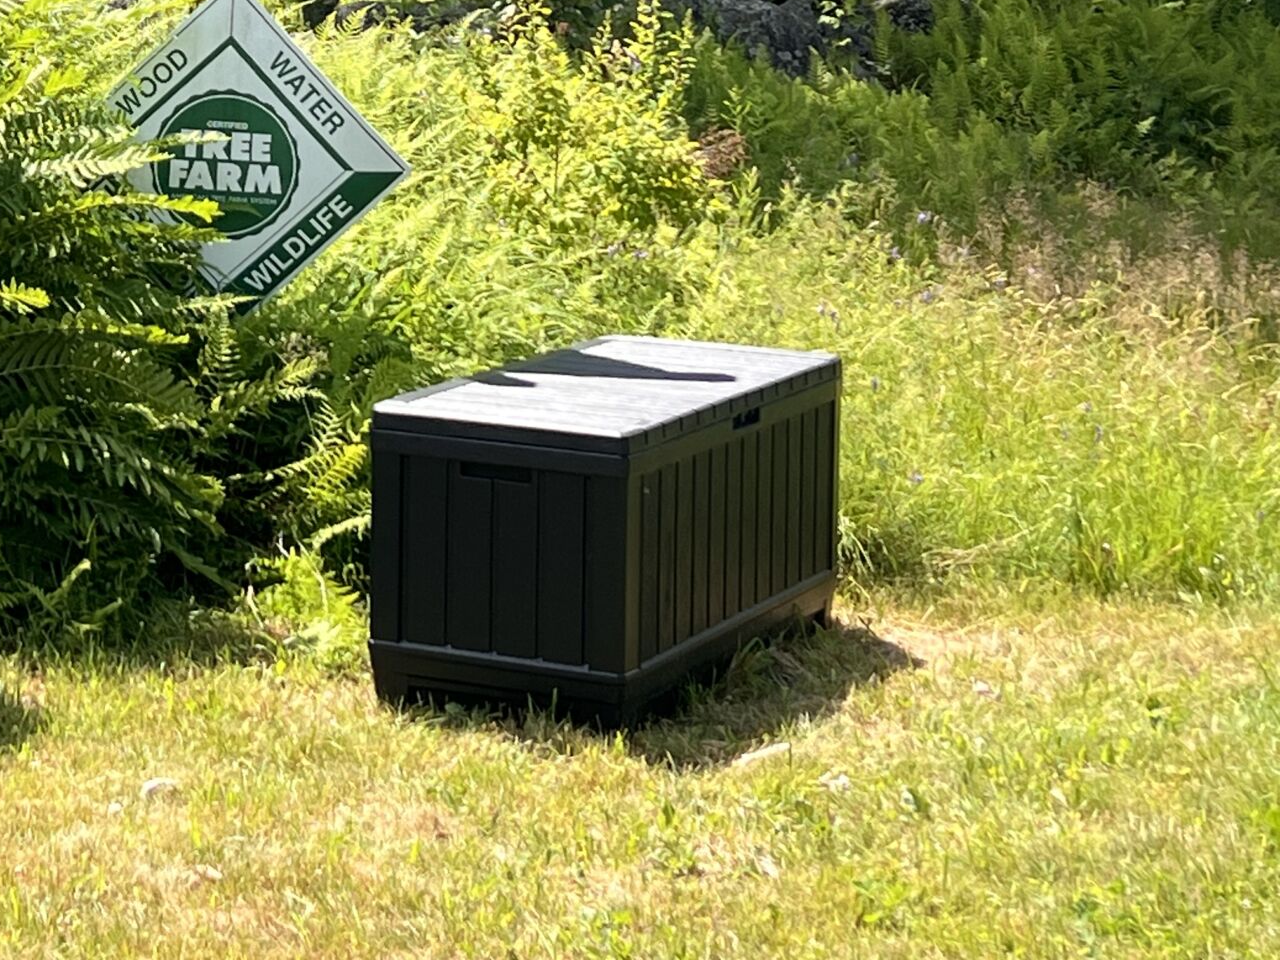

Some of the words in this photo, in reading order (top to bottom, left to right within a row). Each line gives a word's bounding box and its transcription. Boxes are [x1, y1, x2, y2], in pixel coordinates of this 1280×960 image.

[115, 49, 188, 116] WOOD
[269, 51, 345, 136] WATER
[168, 159, 282, 194] FARM
[244, 193, 354, 291] WILDLIFE
